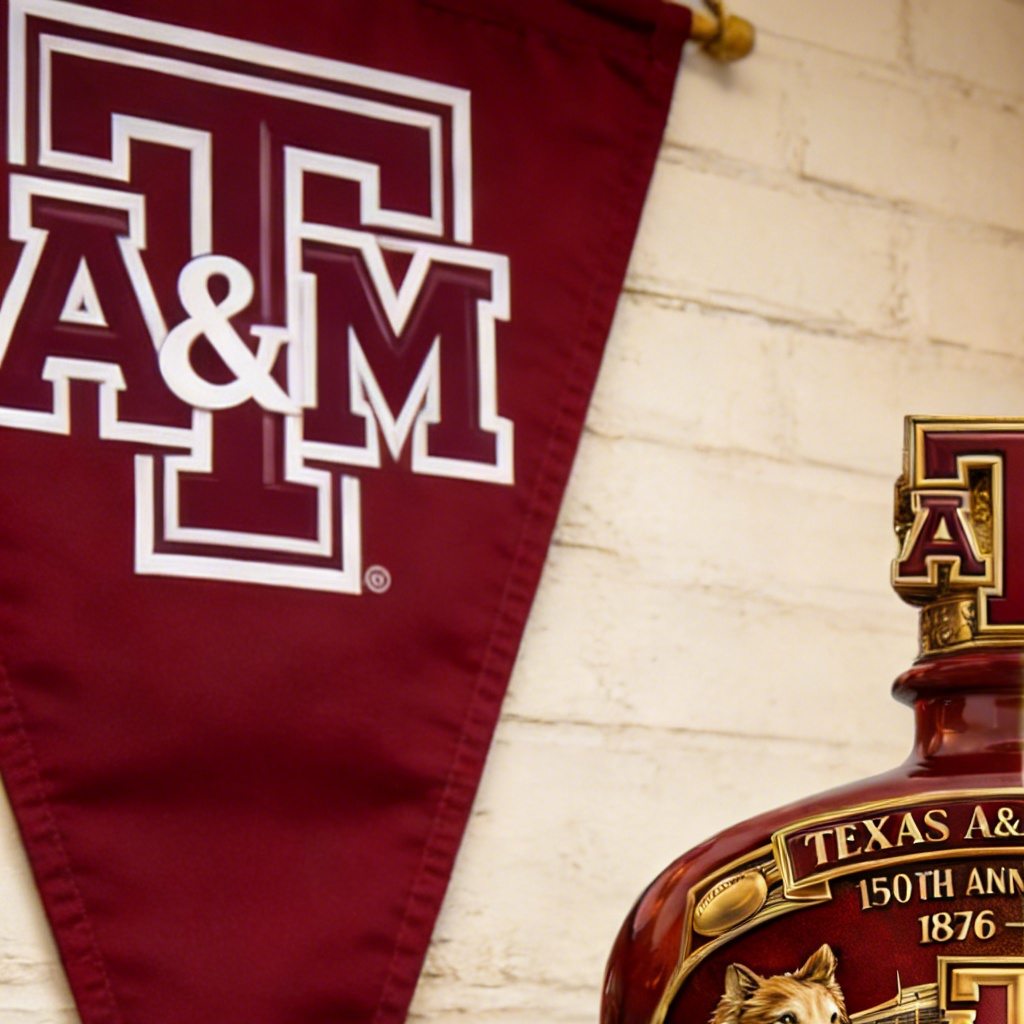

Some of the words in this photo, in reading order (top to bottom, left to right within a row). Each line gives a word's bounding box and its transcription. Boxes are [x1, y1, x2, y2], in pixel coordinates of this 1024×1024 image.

[804, 808, 950, 867] TEXAS
[856, 867, 955, 911] 150TH
[918, 910, 997, 945] 1876
